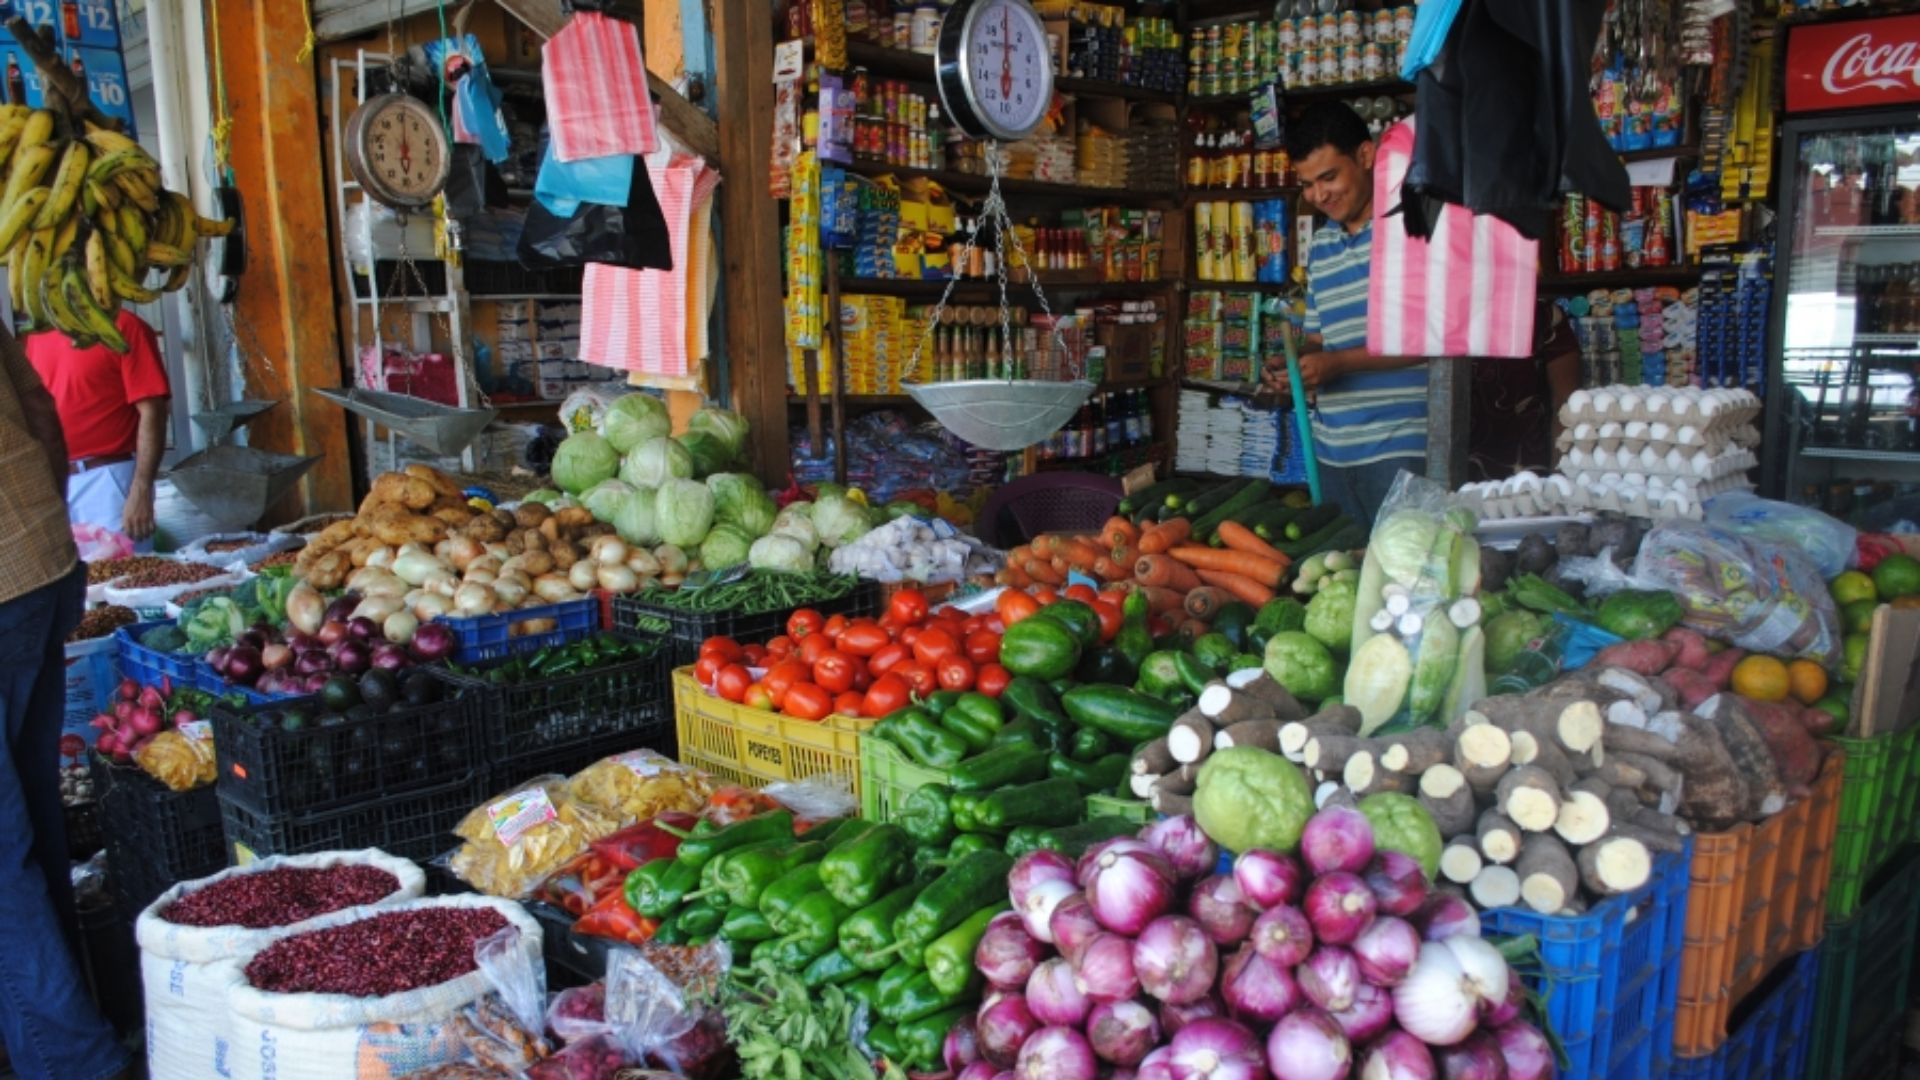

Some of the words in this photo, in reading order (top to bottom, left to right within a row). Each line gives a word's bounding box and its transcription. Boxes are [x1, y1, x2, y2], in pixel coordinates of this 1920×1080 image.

[1016, 31, 1023, 43] 2
[1025, 54, 1032, 64] 4
[978, 68, 989, 81] 14
[1025, 78, 1031, 89] 6
[90, 81, 125, 106] L10
[985, 87, 997, 100] 12
[1016, 93, 1023, 105] 8
[999, 101, 1011, 114] 10
